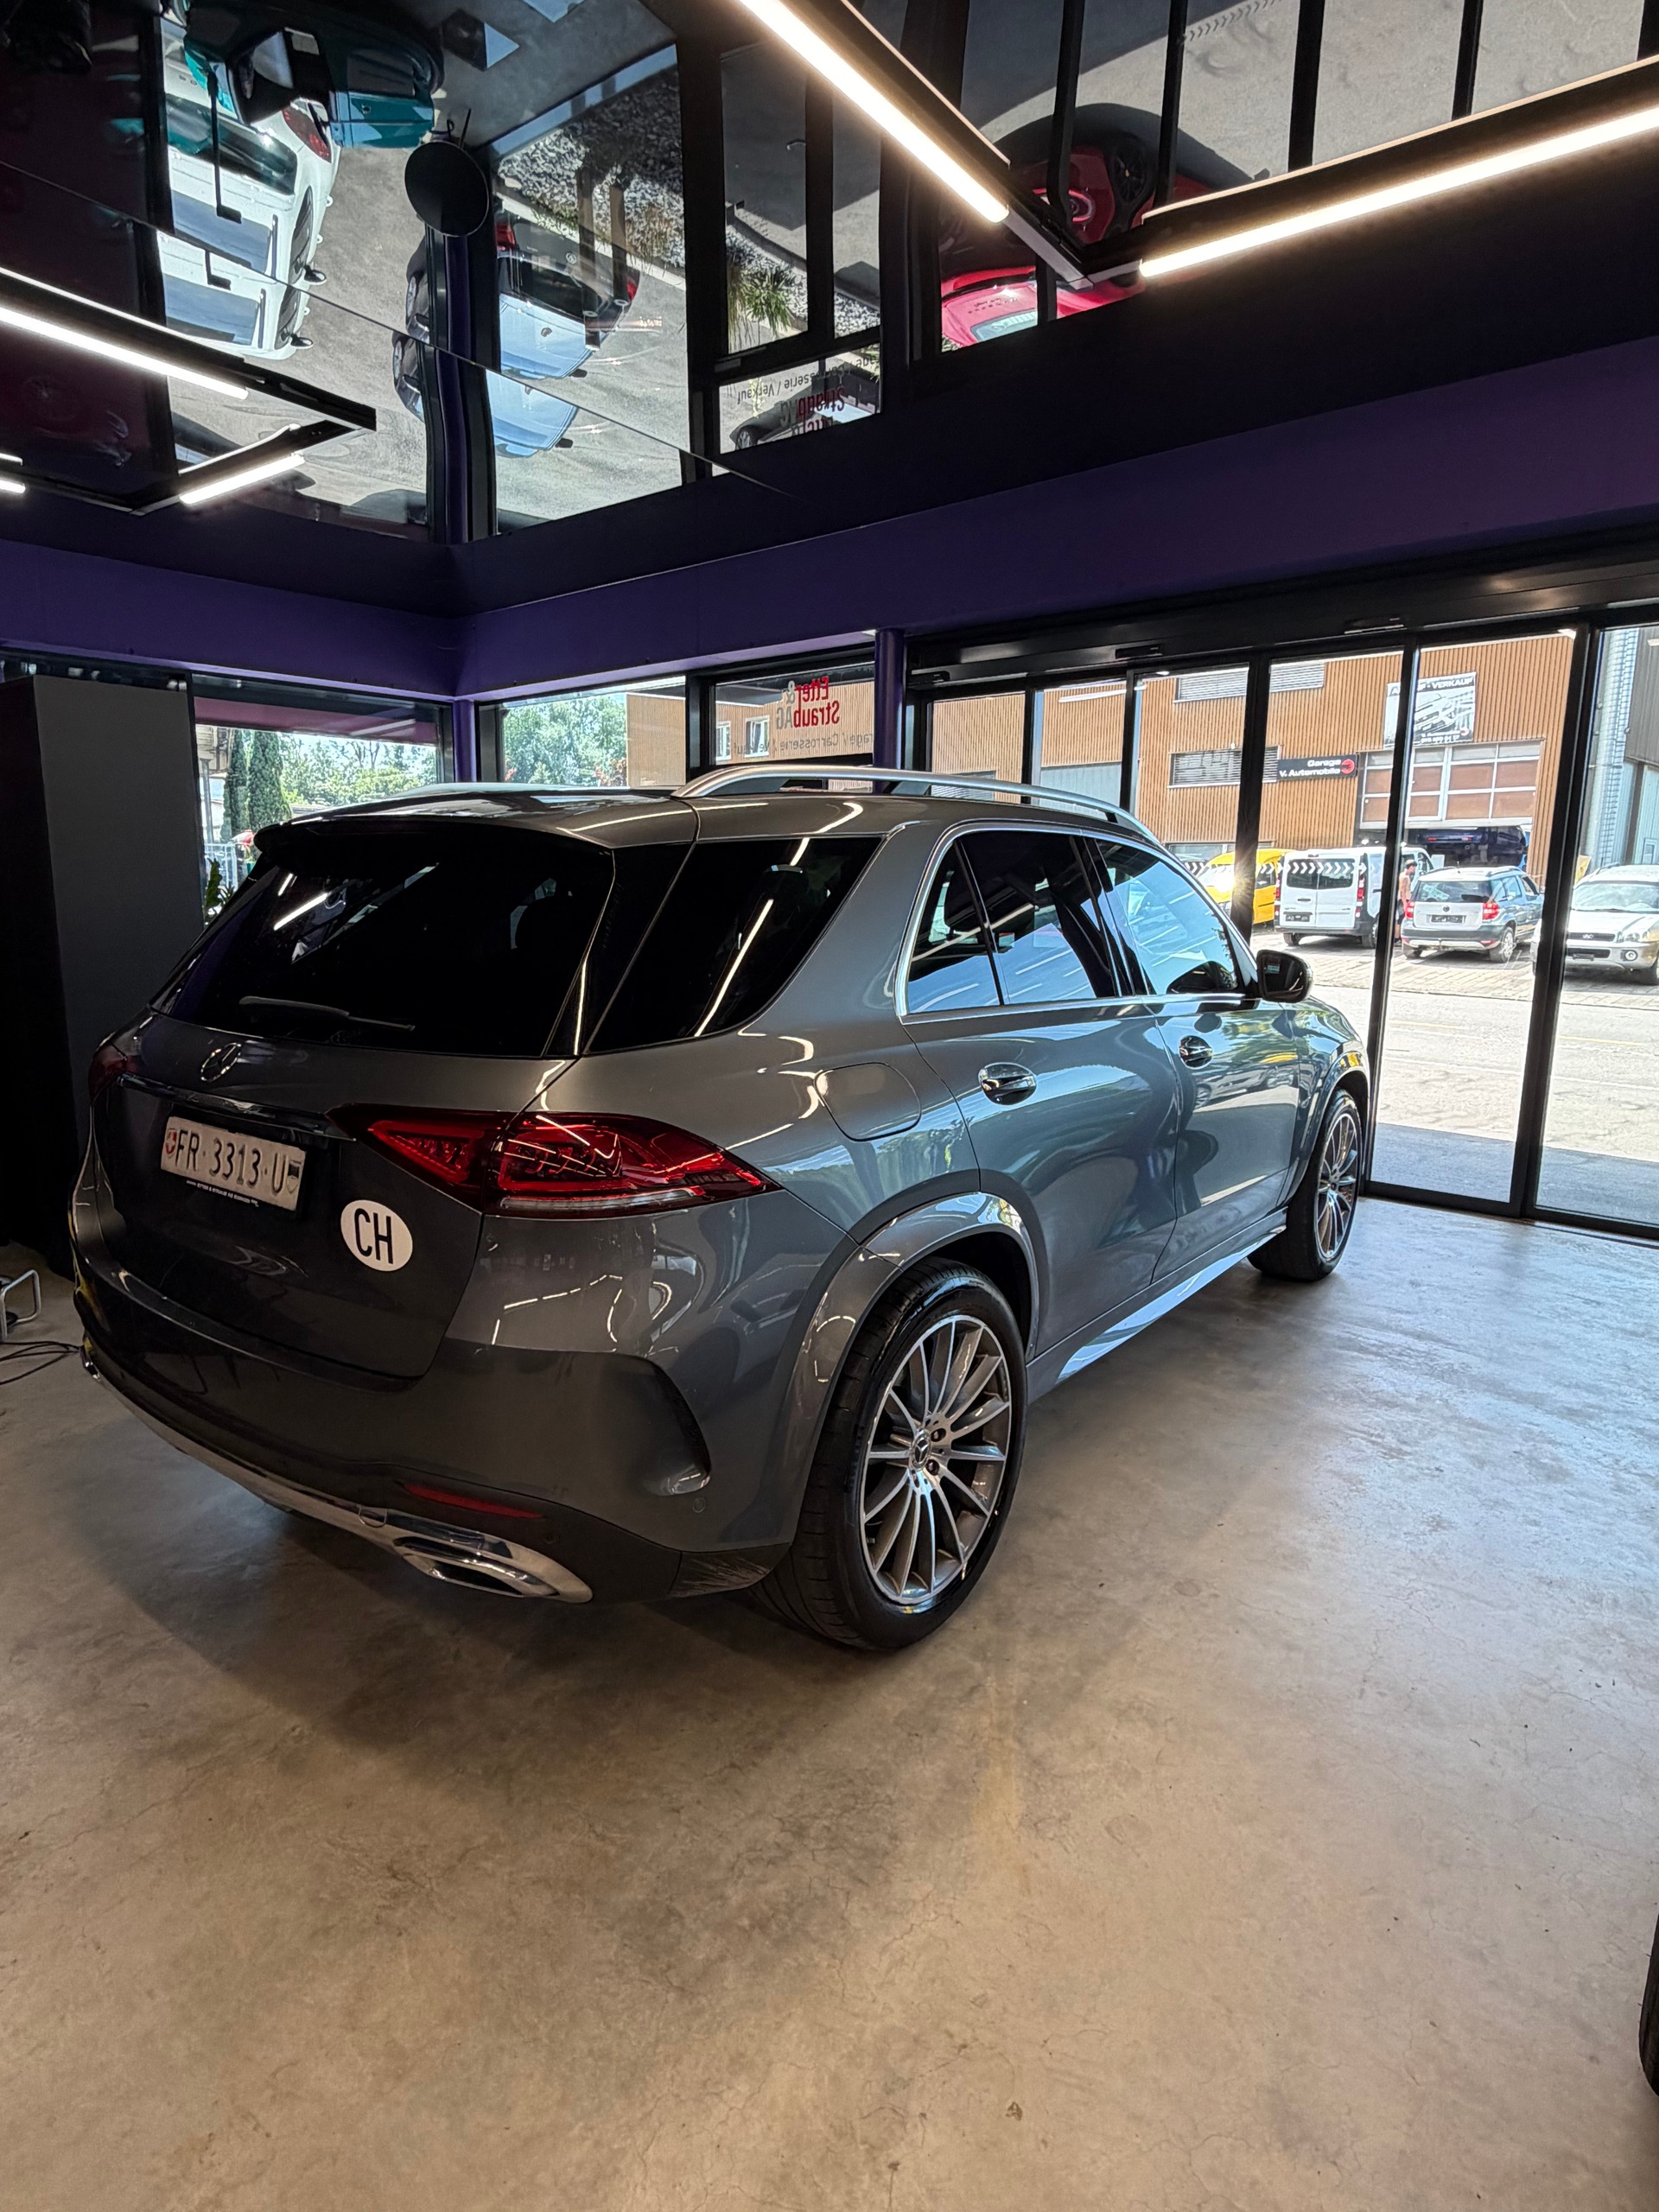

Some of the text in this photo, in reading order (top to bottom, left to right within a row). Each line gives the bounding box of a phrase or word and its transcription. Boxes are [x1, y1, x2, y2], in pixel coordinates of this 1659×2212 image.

[1431, 677, 1473, 690] VERKAUF
[1307, 759, 1342, 767] Garage
[1288, 767, 1341, 777] Automobile
[354, 1208, 393, 1264] CH
